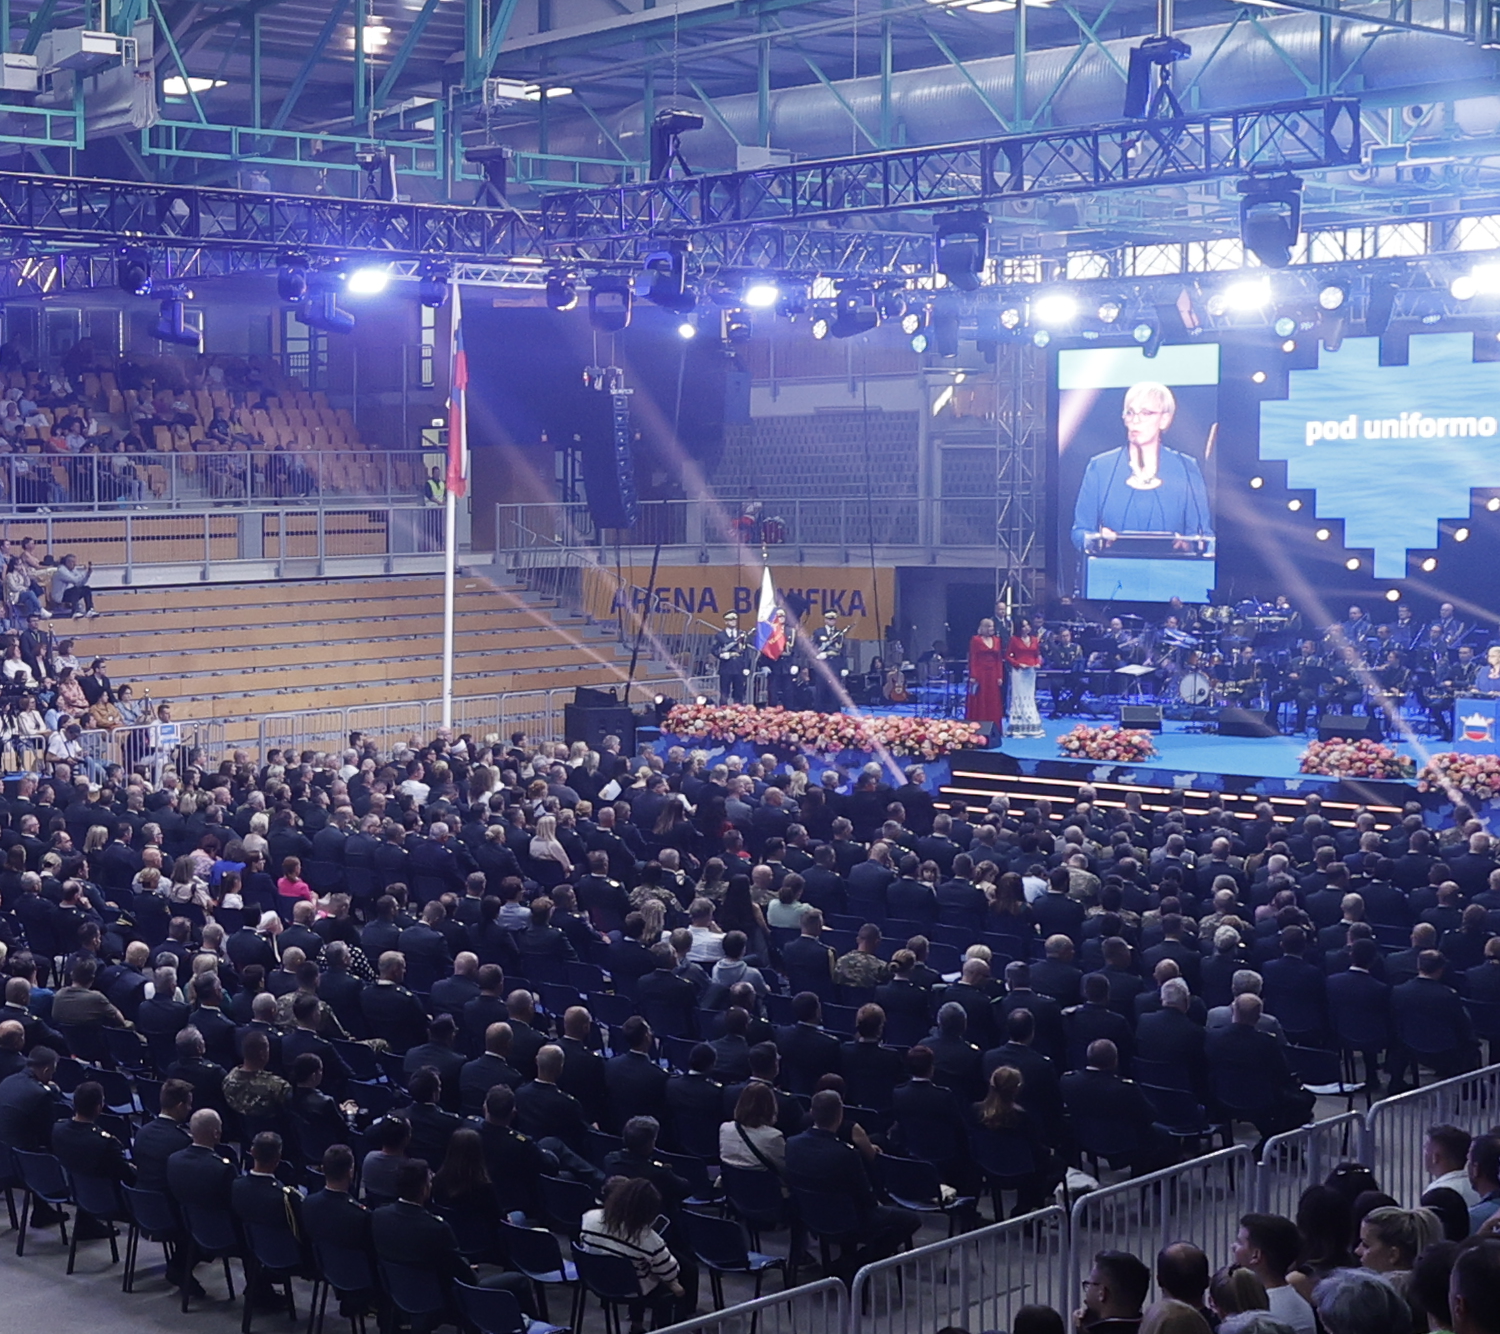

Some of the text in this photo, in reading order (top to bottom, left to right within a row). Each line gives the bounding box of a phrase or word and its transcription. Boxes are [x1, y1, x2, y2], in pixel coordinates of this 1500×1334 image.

[1306, 411, 1497, 446] pod uniformo
[610, 586, 867, 617] ARENA BFIKA
